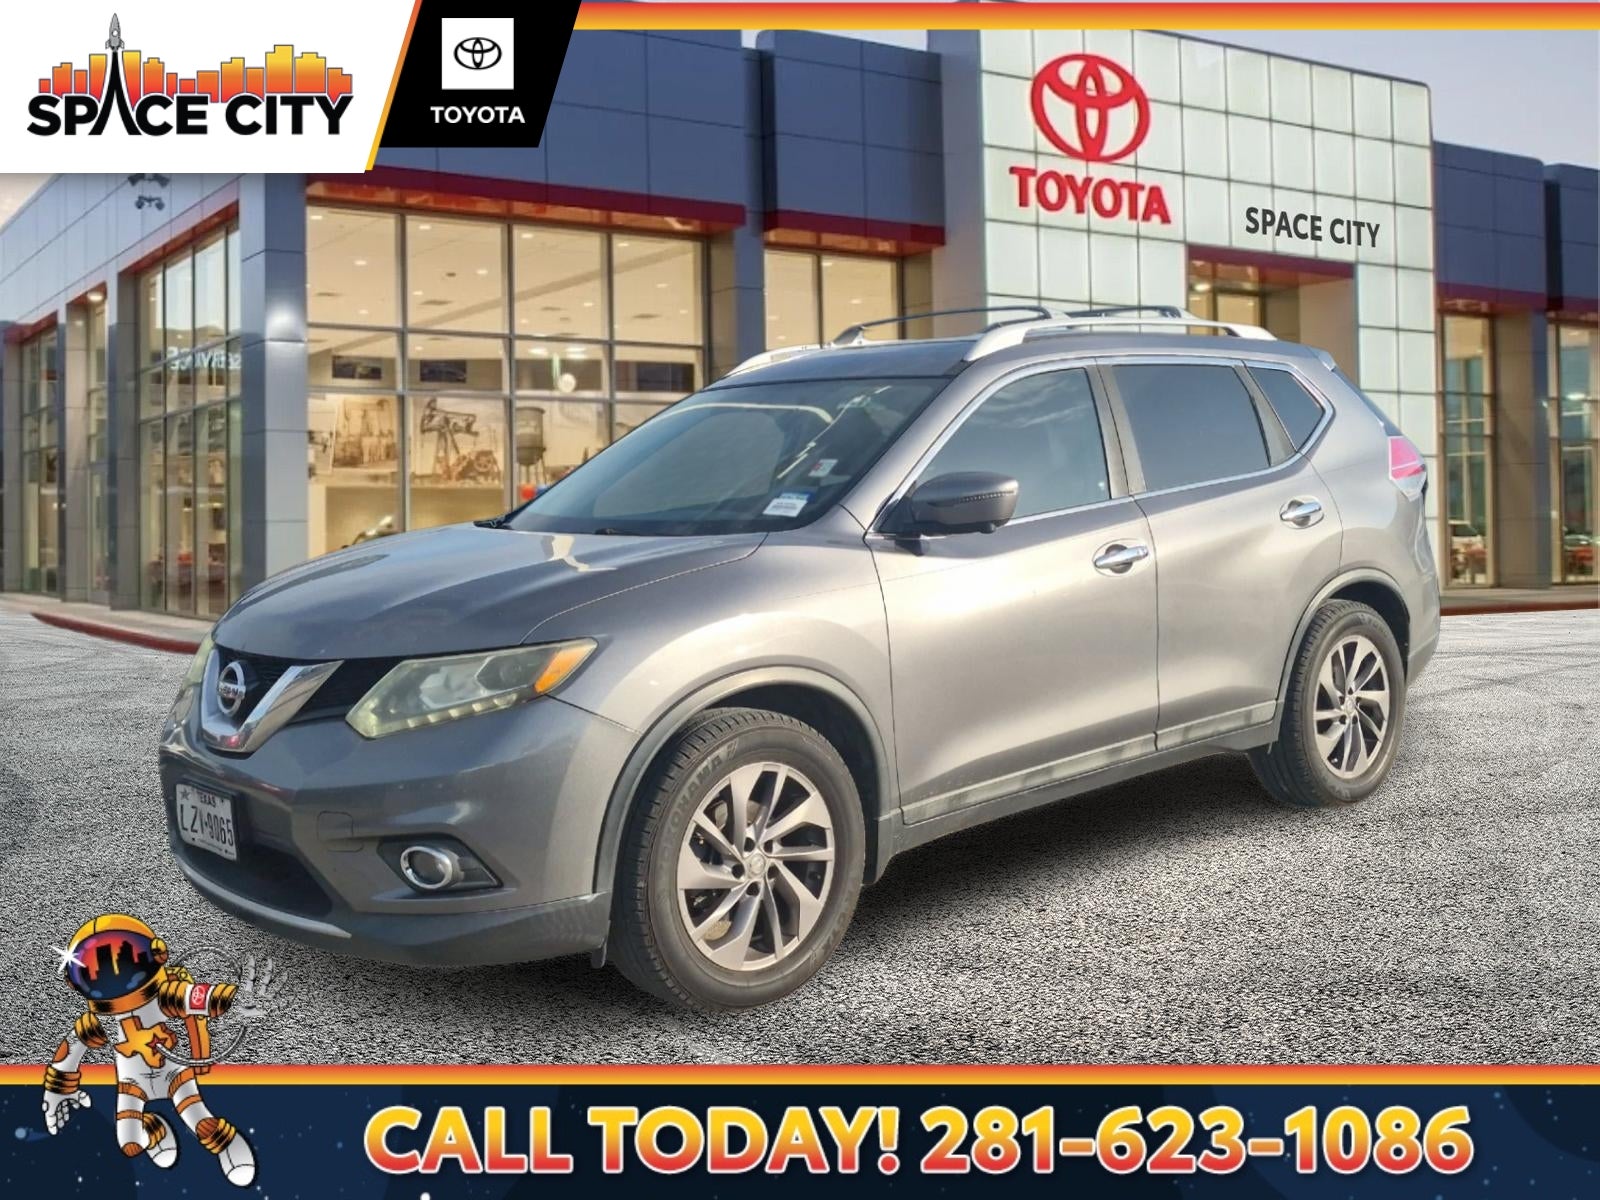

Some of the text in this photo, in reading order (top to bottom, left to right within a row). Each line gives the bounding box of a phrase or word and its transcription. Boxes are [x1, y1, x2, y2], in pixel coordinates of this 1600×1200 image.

[1009, 166, 1171, 225] TOYOTA
[1245, 206, 1380, 248] SPACE CITY
